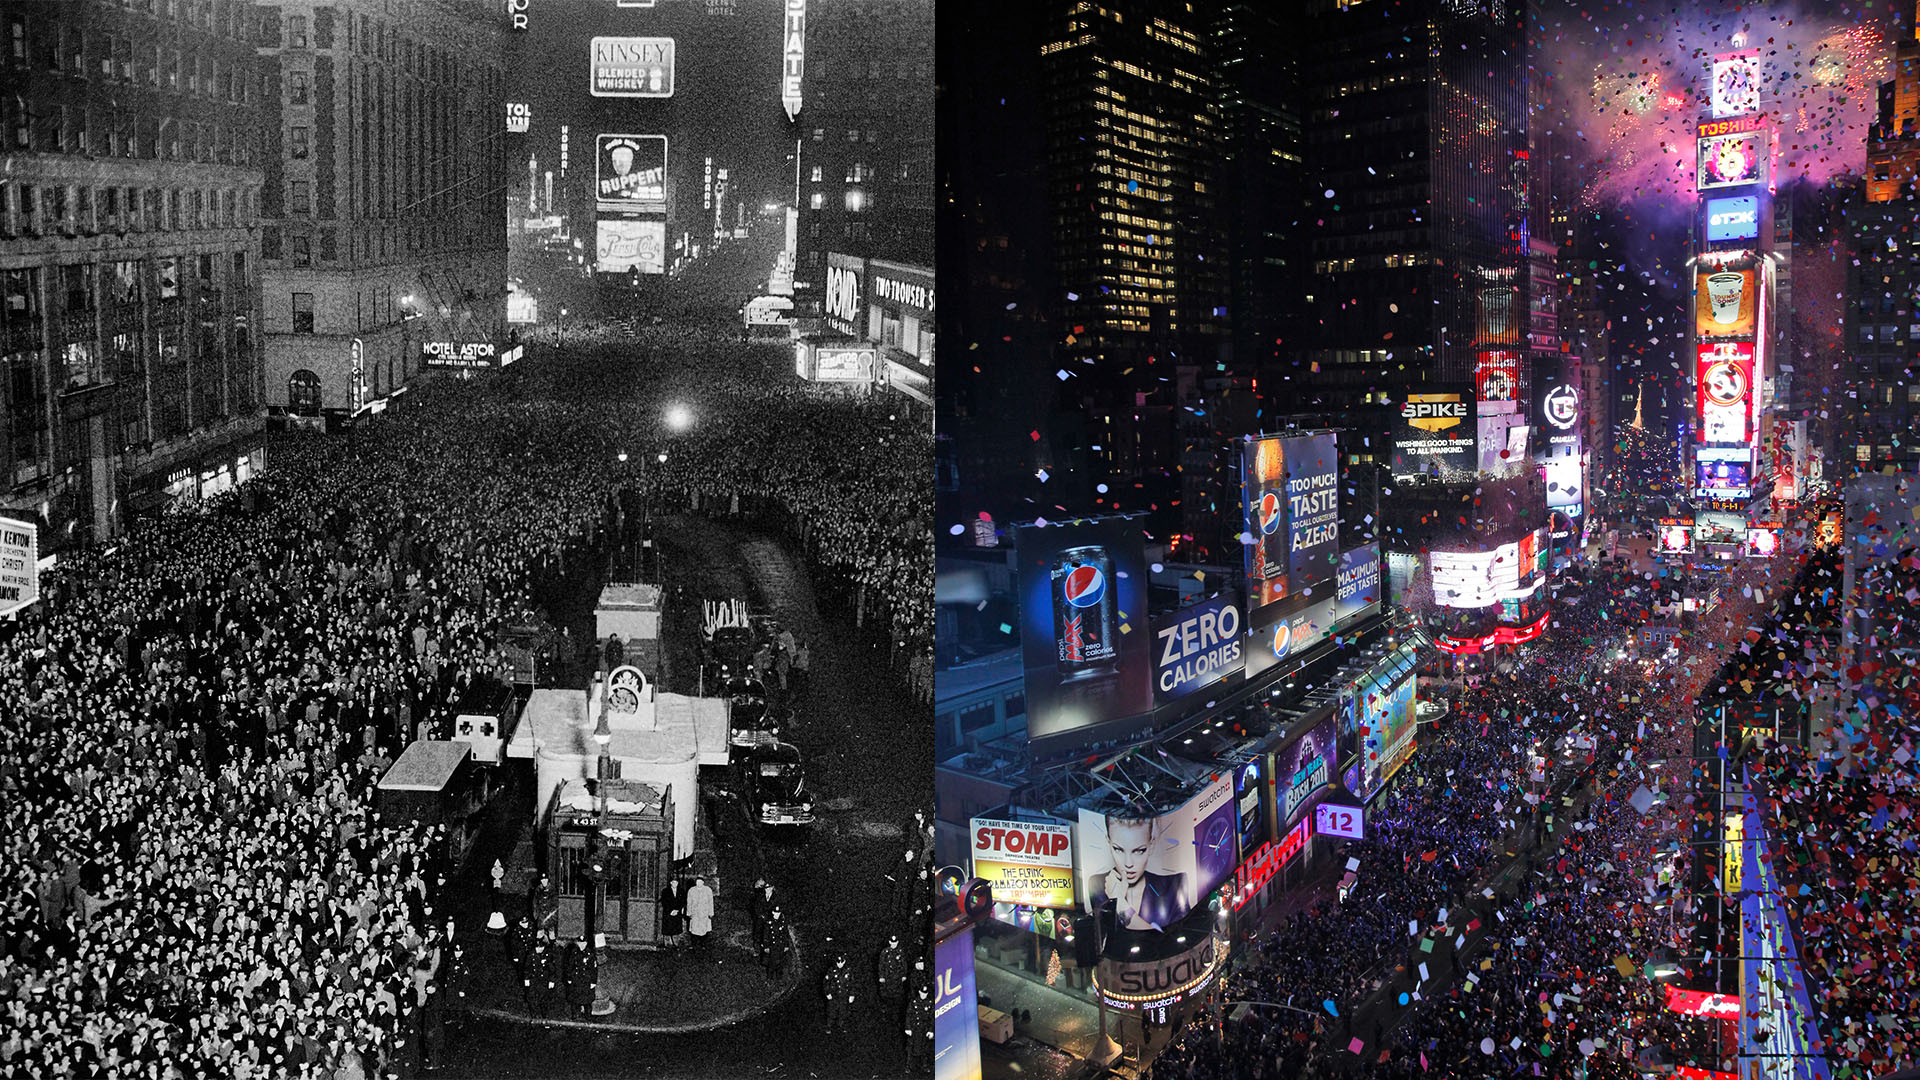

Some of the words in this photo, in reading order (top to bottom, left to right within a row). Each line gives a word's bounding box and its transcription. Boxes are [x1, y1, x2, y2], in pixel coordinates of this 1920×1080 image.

[597, 43, 668, 63] KINSEY
[598, 68, 646, 78] BLENDED
[598, 78, 645, 89] WHISKEY
[1697, 113, 1767, 137] TOSHIBA
[600, 167, 663, 194] RUPPERT
[826, 267, 858, 322] BOND
[423, 342, 456, 355] HOTEL
[460, 343, 494, 357] ASTOR
[1402, 403, 1467, 418] SPIKE
[1396, 440, 1426, 448] WISHING
[1427, 440, 1448, 448] GOOD
[1417, 447, 1430, 455] ALL
[1290, 477, 1311, 493] TOO
[1311, 472, 1337, 489] MUCH
[1290, 488, 1337, 518] TASTE
[1291, 521, 1300, 530] TO
[1299, 518, 1312, 528] CALL
[4, 530, 30, 549] KENTON
[1291, 531, 1303, 553] A
[1303, 521, 1338, 549] ZERO
[1337, 559, 1378, 588] MAXIMUM
[1338, 582, 1357, 601] PEPSI
[1357, 573, 1378, 591] TASTE
[1063, 612, 1085, 663] MAX
[1158, 605, 1240, 668] ZERO
[1160, 640, 1241, 692] CALORIES
[1198, 785, 1226, 812] swatch
[1329, 811, 1353, 832] 12
[976, 827, 1069, 857] STOMP
[1251, 854, 1271, 884] Foot
[1273, 827, 1301, 859] Locker
[1002, 868, 1018, 879] THE
[1018, 867, 1045, 879] FLYING
[1030, 878, 1072, 890] BROTHERS
[935, 996, 961, 1019] DESIGN
[1142, 996, 1177, 1010] swatch
